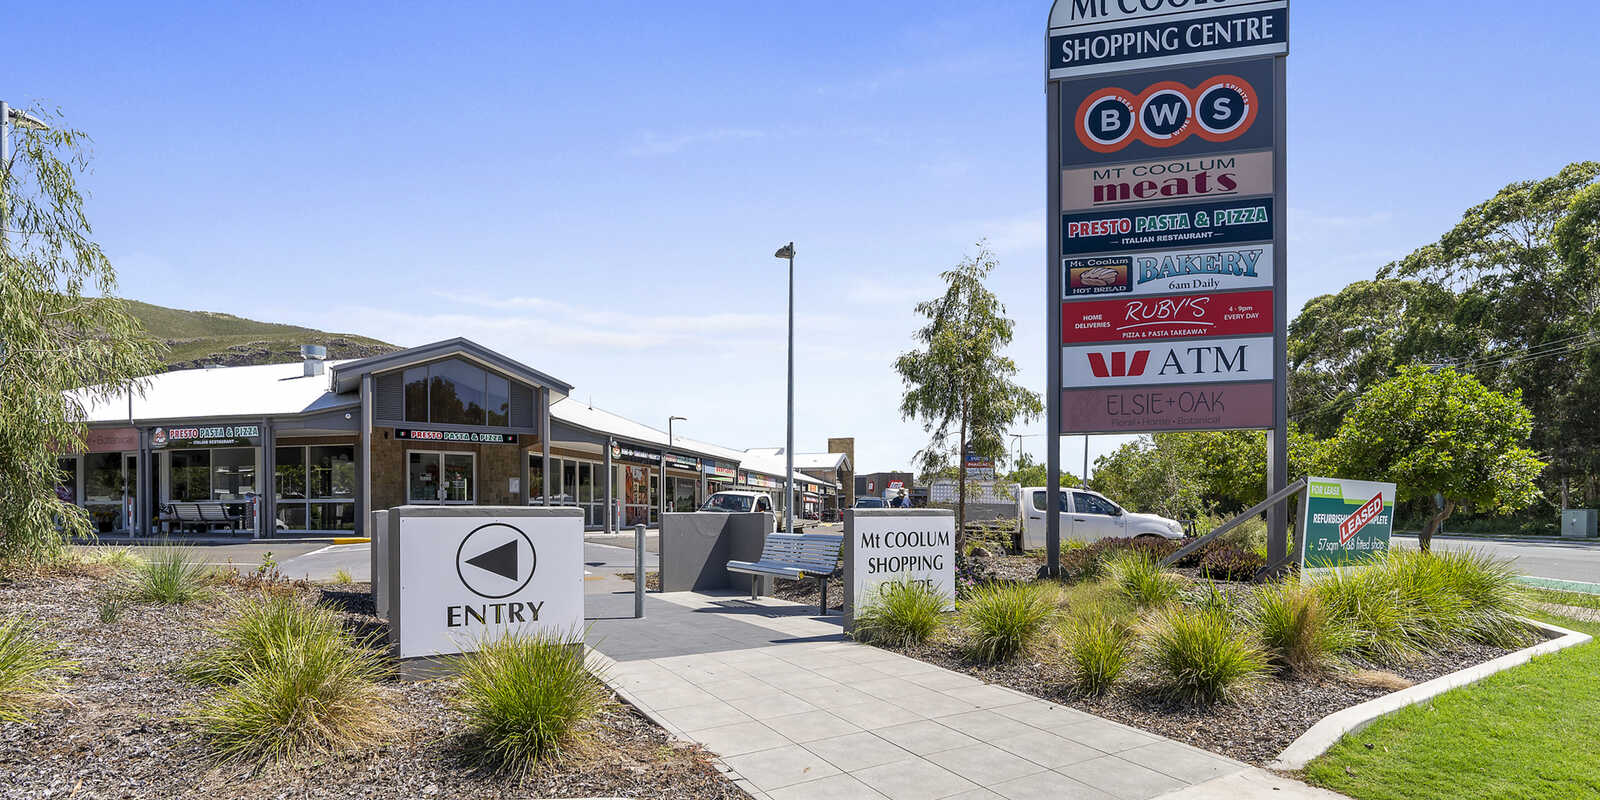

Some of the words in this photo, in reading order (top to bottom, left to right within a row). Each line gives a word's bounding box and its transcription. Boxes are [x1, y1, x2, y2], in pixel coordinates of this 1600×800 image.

[1062, 27, 1179, 63] SHOPPING
[1185, 15, 1273, 48] CENTRE
[1093, 168, 1125, 180] MT
[1132, 158, 1236, 177] COOLUM
[1093, 171, 1237, 202] meats
[1068, 218, 1131, 238] PRESTO
[1136, 213, 1190, 233] PASTA
[1195, 211, 1210, 228] &
[1214, 207, 1269, 226] PIZZA
[1121, 236, 1155, 245] ITALIAN
[1157, 232, 1213, 242] RESTAURANT
[1137, 249, 1264, 285] BAKERY
[1168, 279, 1191, 290] 6am
[1193, 278, 1220, 290] Daily
[1125, 297, 1210, 321] RUBY'S
[1239, 305, 1253, 313] 9pm
[1074, 321, 1110, 329] DELIVERIES
[1170, 328, 1207, 336] TAKEAWAY
[1158, 345, 1248, 375] ATM
[170, 428, 198, 439] PRESTO
[200, 427, 224, 438] PASTA
[226, 427, 233, 437] &
[234, 426, 258, 436] PIZZA
[411, 430, 442, 439] PRESTO
[444, 432, 469, 440] PASTA
[471, 433, 478, 441] &
[480, 434, 504, 442] PIZZA
[1312, 485, 1322, 496] FOR
[1324, 486, 1340, 496] LEASE
[1341, 498, 1381, 540] LEASED
[861, 533, 880, 549] Mt
[885, 531, 950, 548] COOLUM
[1318, 538, 1338, 554] 57sqm
[868, 555, 943, 573] SHOPPING
[447, 601, 544, 627] ENTRY
